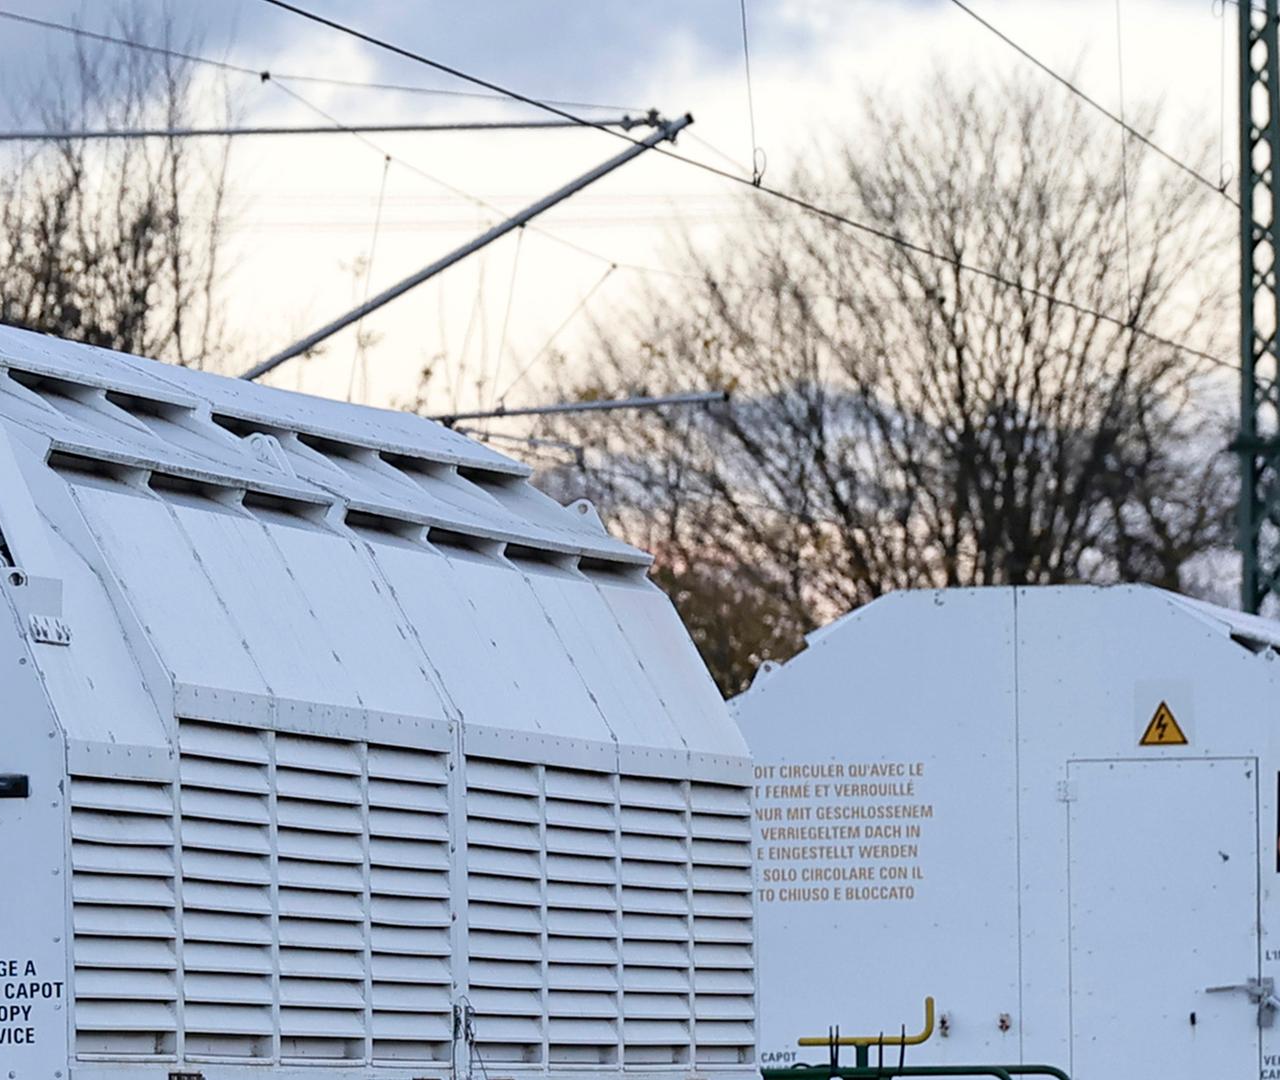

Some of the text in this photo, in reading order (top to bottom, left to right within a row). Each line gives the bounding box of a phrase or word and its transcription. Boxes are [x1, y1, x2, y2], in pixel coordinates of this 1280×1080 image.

[779, 764, 844, 779] CIRCULER
[848, 763, 905, 778] QU'AVEC
[909, 763, 924, 776] LE
[765, 778, 810, 798] FERMÉ
[815, 784, 830, 797] ET
[834, 779, 915, 798] VERROUILLÉ
[755, 805, 933, 821] NUR MIT GESCHLOSSENEM
[761, 825, 920, 840] VERRIEGELTEM DACH IN
[769, 846, 854, 860] EINGESTELLT
[859, 845, 918, 859] WERDEN
[763, 866, 924, 881] SOLO CIRCOLARE CON IL
[757, 886, 914, 901] TO CHIUSO E BLOCCATO
[24, 960, 36, 976] A
[5, 982, 64, 1000] CAPOT
[761, 1051, 796, 1063] CAPOT
